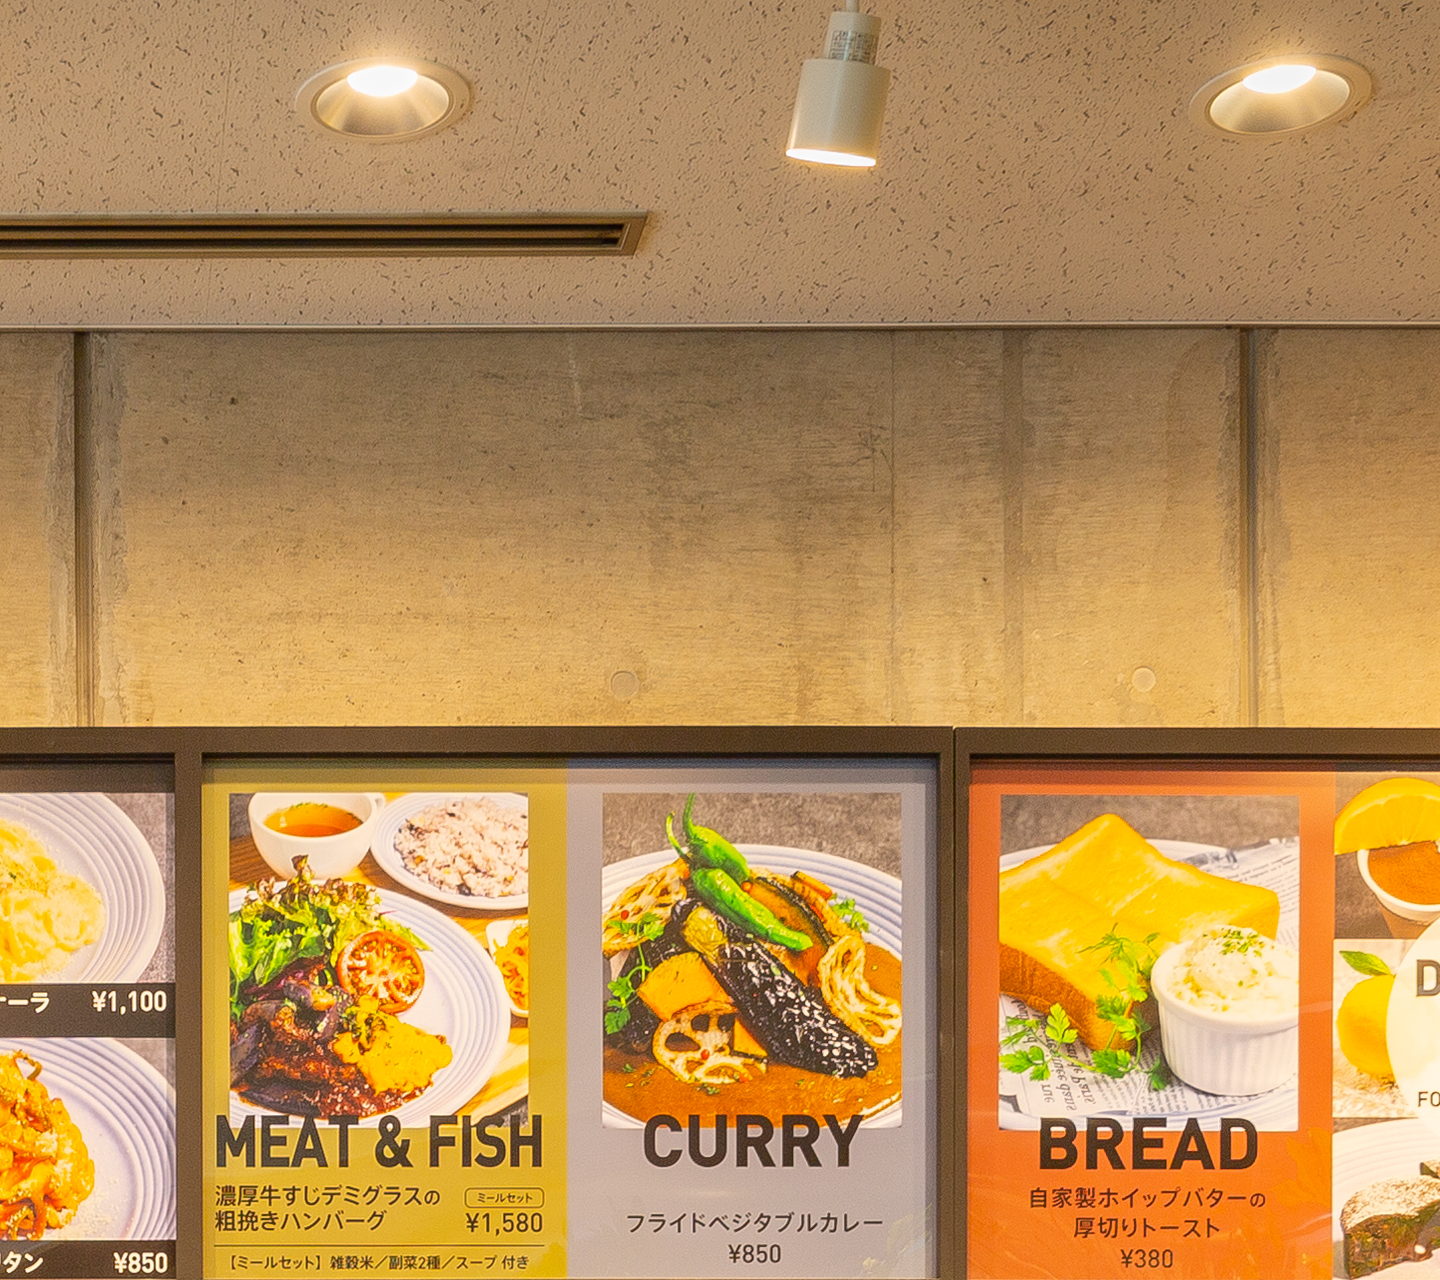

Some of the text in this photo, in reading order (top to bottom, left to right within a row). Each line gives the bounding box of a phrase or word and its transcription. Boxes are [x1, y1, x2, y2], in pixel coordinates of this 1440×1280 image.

[92, 990, 167, 1014] ¥1,100
[216, 1114, 543, 1168] MEAT & FISH
[643, 1113, 864, 1169] CURRY
[1039, 1117, 1259, 1171] BREAD
[215, 1186, 440, 1207] 濃厚牛すじデミグラスの
[477, 1192, 533, 1204] ミールセット
[1029, 1186, 1266, 1209] 自家製ホイップバターの
[215, 1210, 387, 1232] 粗挽きハンバーグ
[466, 1212, 543, 1236] ¥1,580
[625, 1212, 884, 1235] フライドベジタブルカレー
[1073, 1216, 1221, 1239] 厚切りトースト
[114, 1252, 169, 1274] ¥850
[728, 1243, 781, 1265] ¥850
[1120, 1248, 1174, 1270] ¥380
